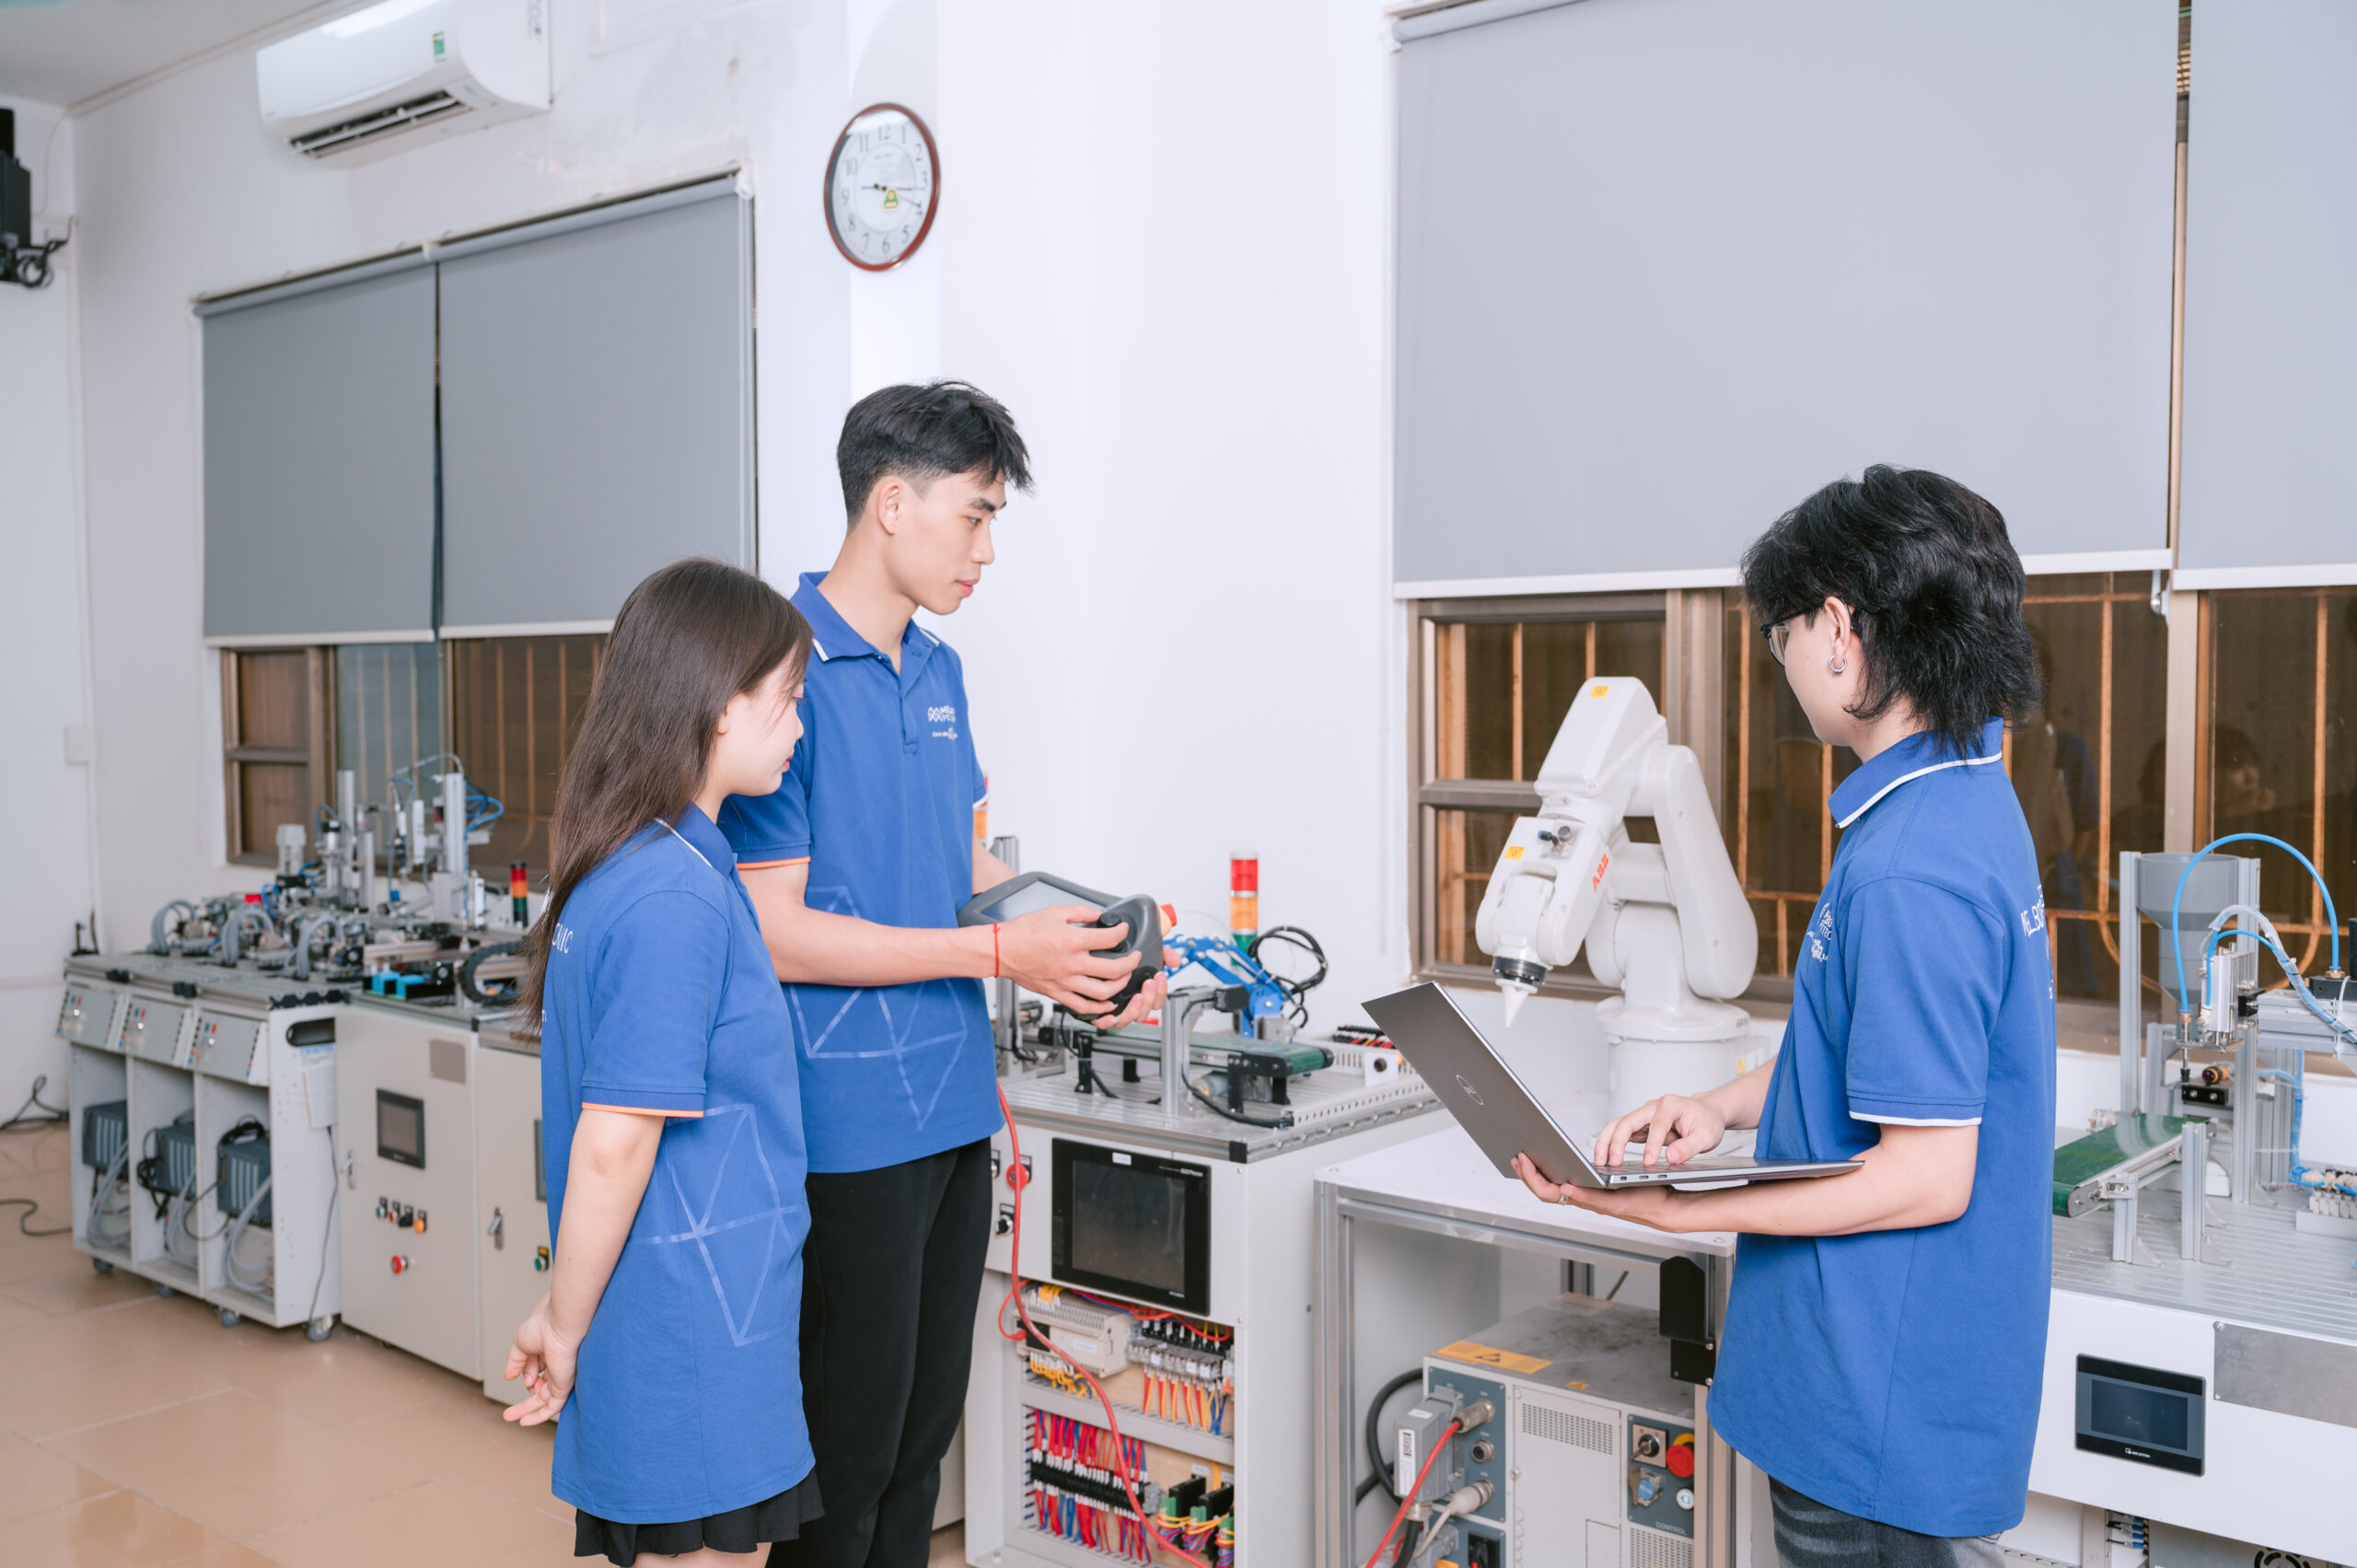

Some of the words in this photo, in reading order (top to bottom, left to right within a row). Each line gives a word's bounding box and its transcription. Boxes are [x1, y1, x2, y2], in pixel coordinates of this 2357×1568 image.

[877, 123, 891, 142] 12
[859, 132, 869, 153] 11
[914, 142, 923, 161] 2
[844, 157, 858, 177] 10
[922, 170, 928, 190] 3
[842, 187, 850, 205] 9
[848, 214, 856, 232] 8
[863, 232, 870, 254] 7
[901, 225, 910, 244] 5
[882, 236, 890, 254] 6
[1592, 853, 1609, 892] ABB
[1655, 1521, 1688, 1536] CONTROL
